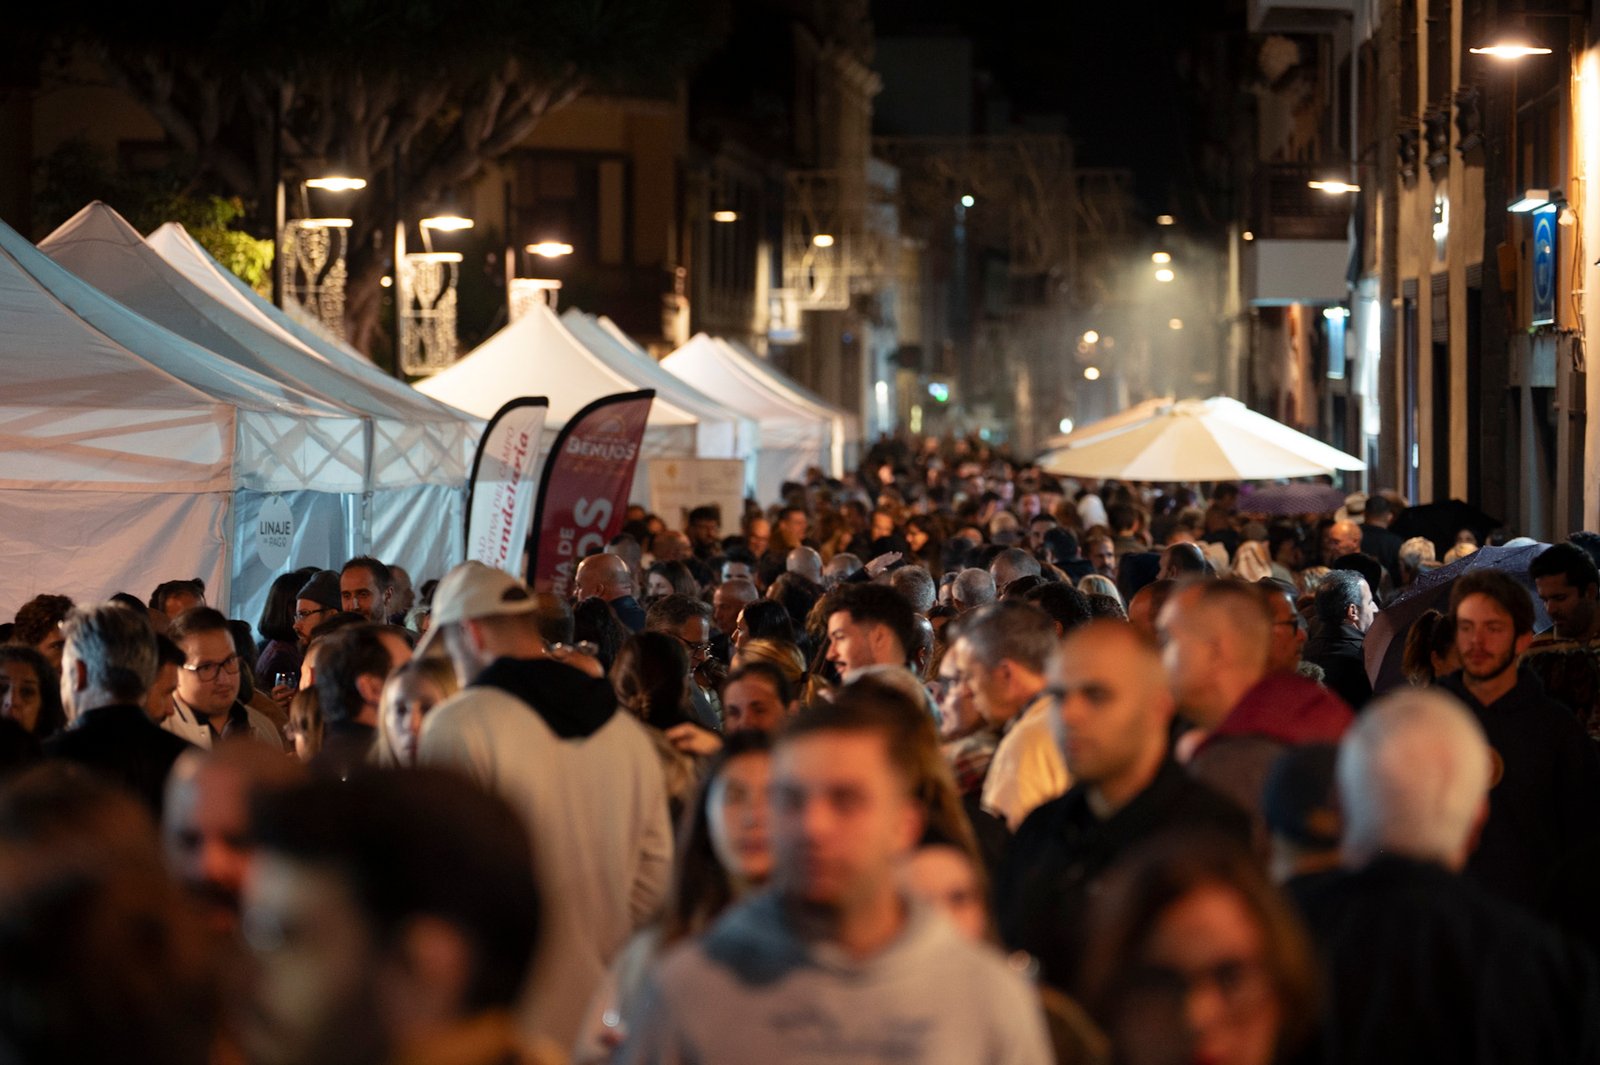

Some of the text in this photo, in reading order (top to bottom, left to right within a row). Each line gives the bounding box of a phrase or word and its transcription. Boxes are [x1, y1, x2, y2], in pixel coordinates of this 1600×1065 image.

[260, 521, 291, 536] LINAJE
[487, 512, 499, 566] RATIVA
[558, 527, 575, 556] DE
[478, 535, 487, 562] AD
